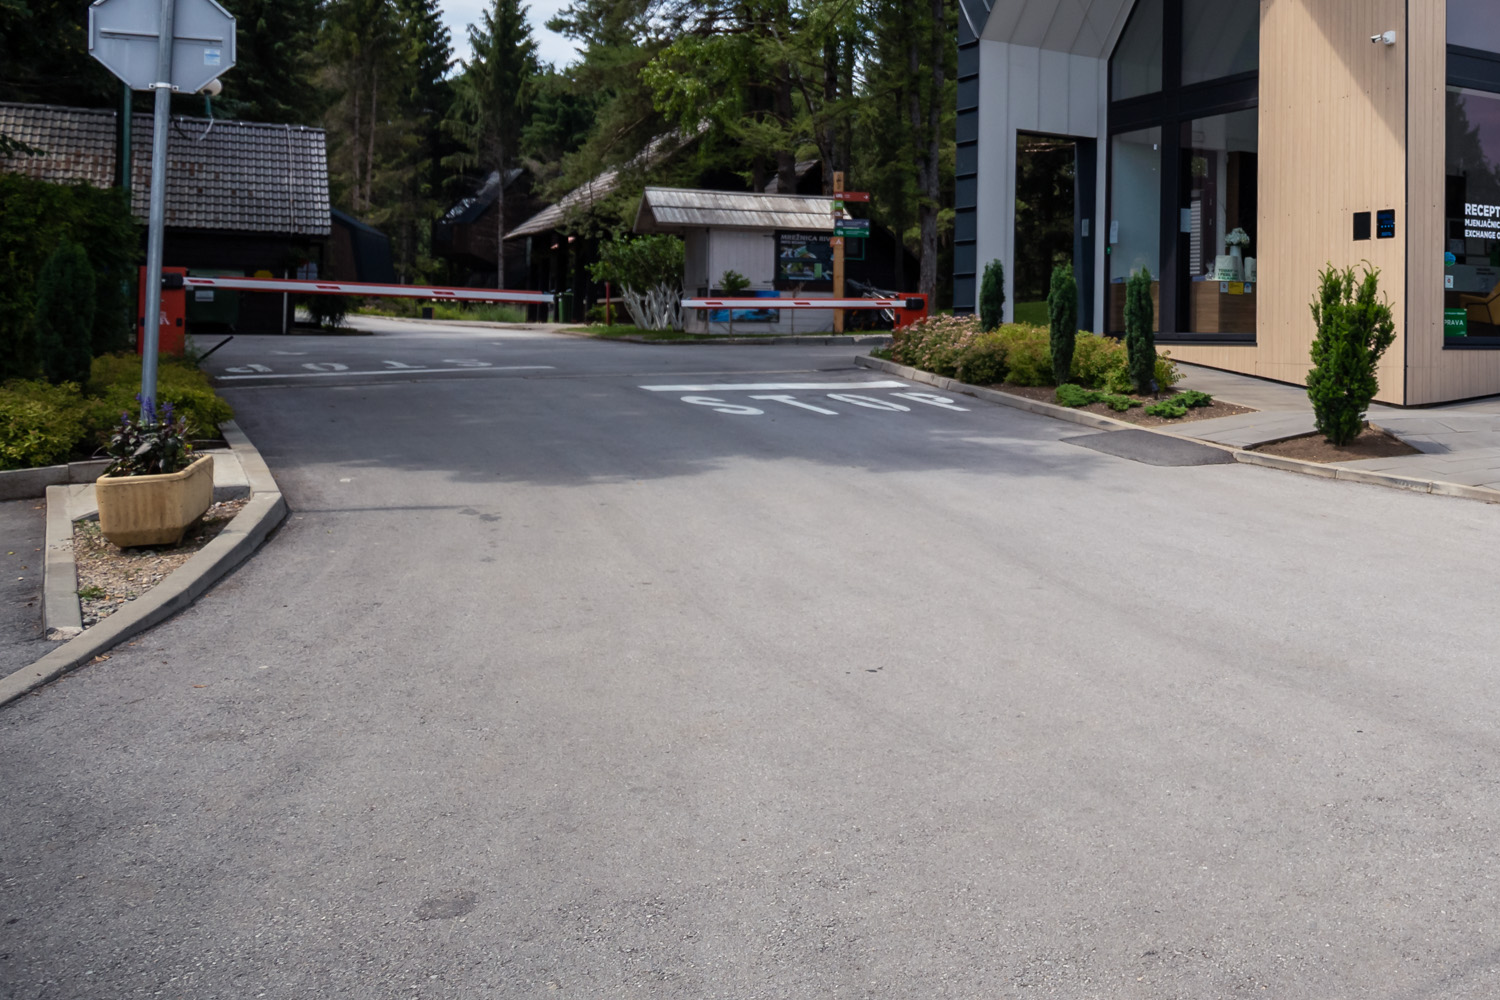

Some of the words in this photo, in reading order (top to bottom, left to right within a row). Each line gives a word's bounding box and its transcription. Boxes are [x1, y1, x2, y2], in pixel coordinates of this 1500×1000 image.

[1464, 229, 1496, 240] EXCHANGE
[225, 358, 493, 374] STOP
[680, 393, 972, 415] STOP
